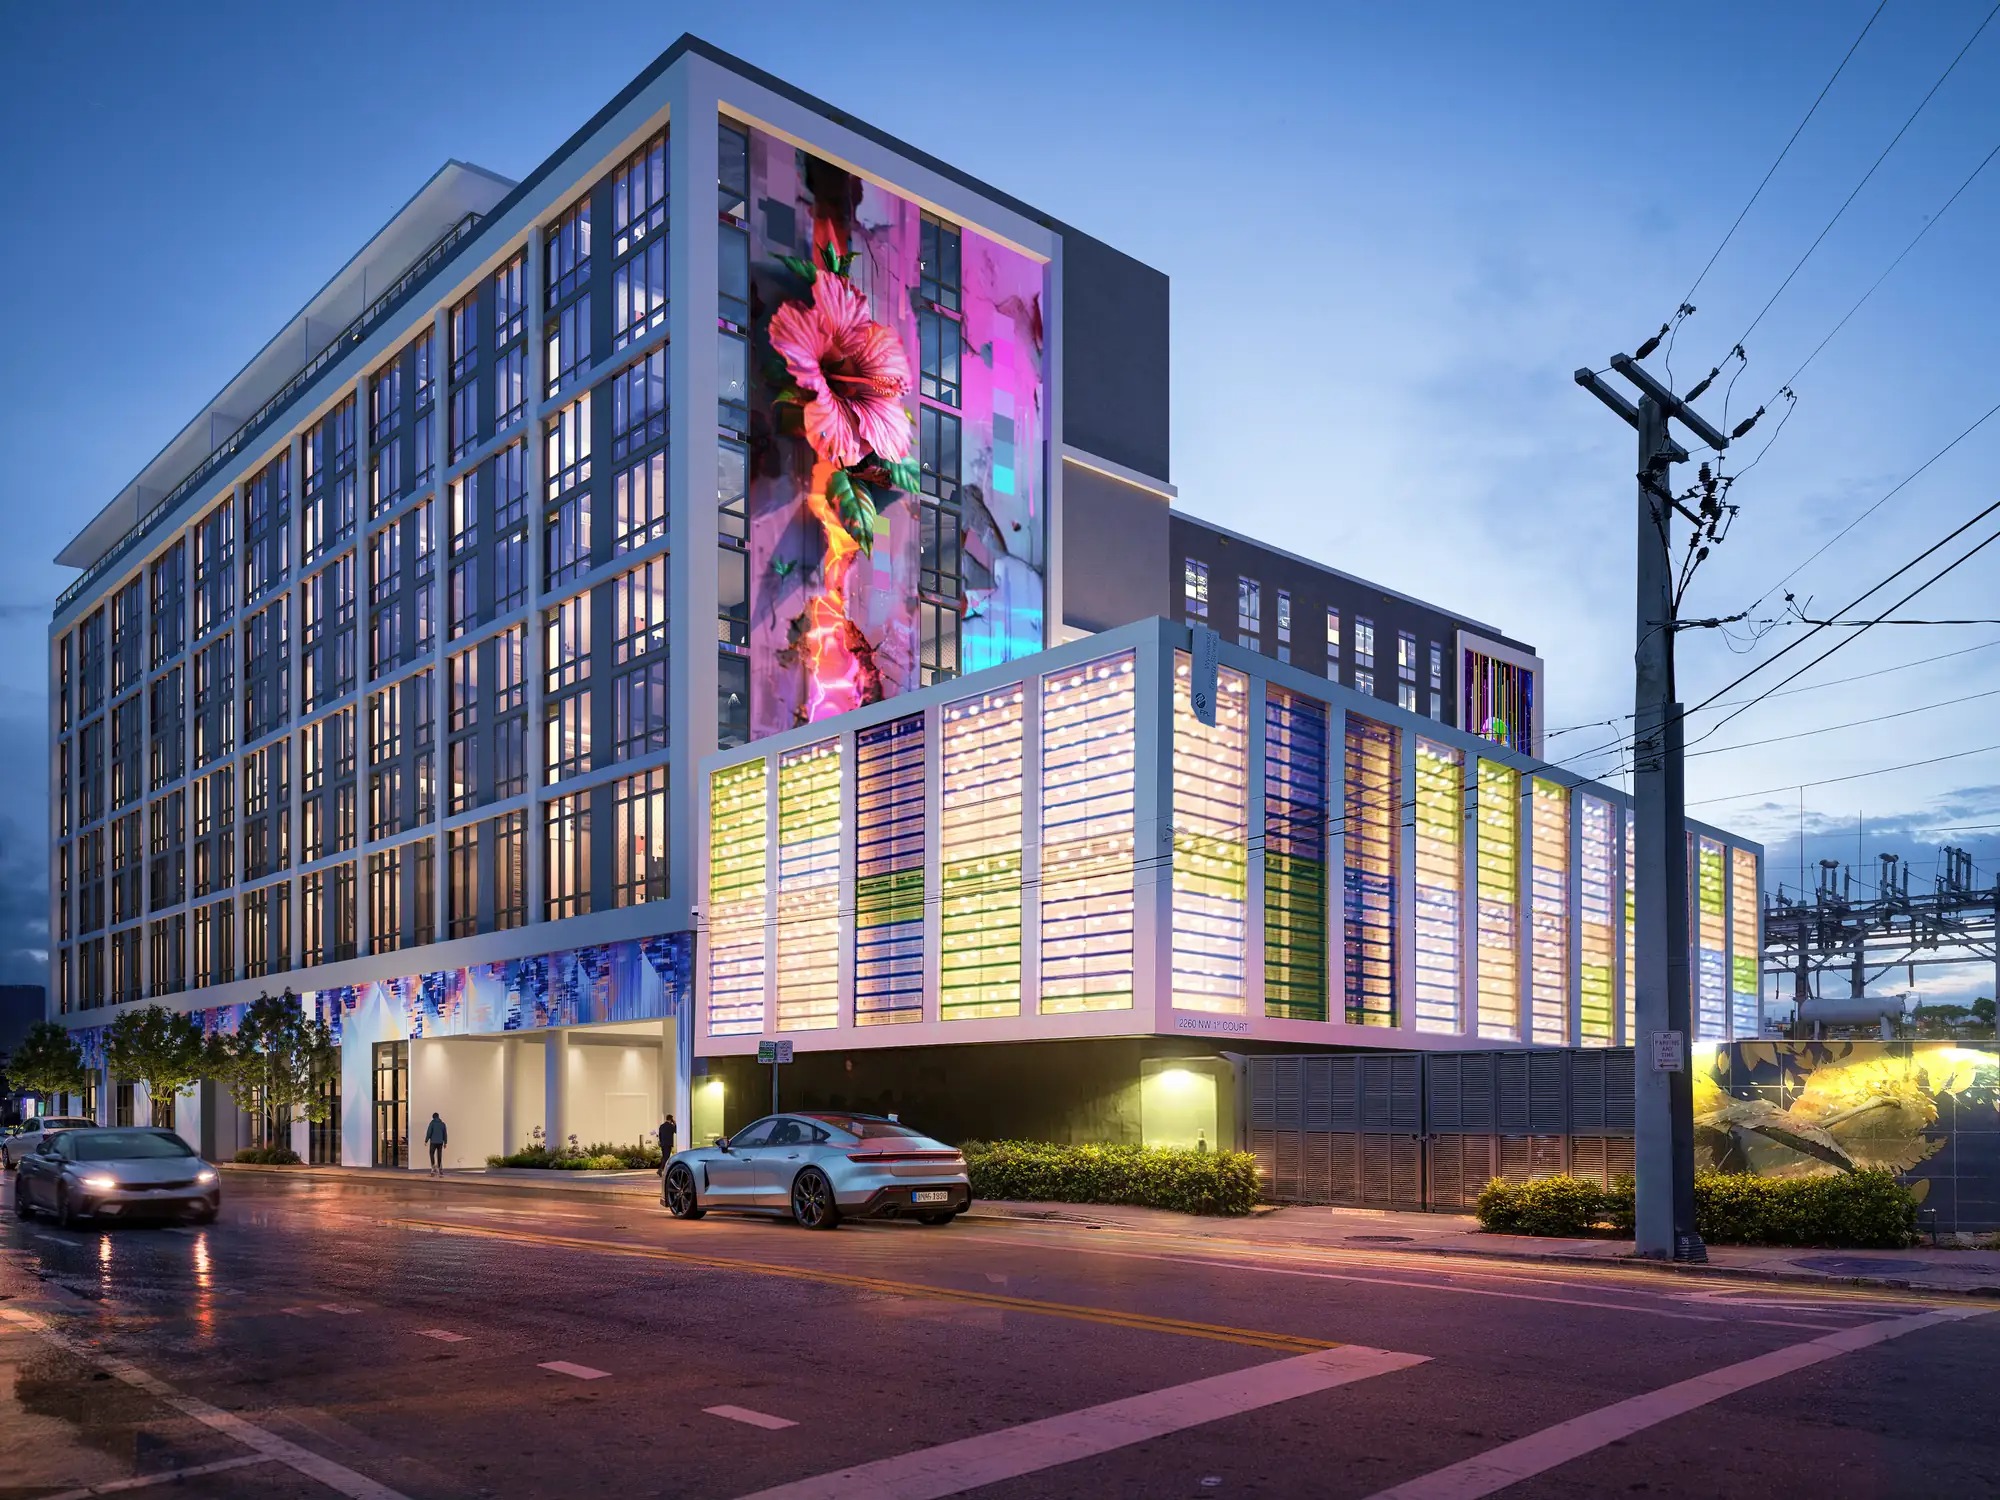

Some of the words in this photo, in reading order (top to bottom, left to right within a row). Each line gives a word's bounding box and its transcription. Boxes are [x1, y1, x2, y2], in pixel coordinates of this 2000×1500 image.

[1179, 1018, 1197, 1029] 2260
[1198, 1019, 1211, 1029] NW
[1222, 1021, 1248, 1032] COURT
